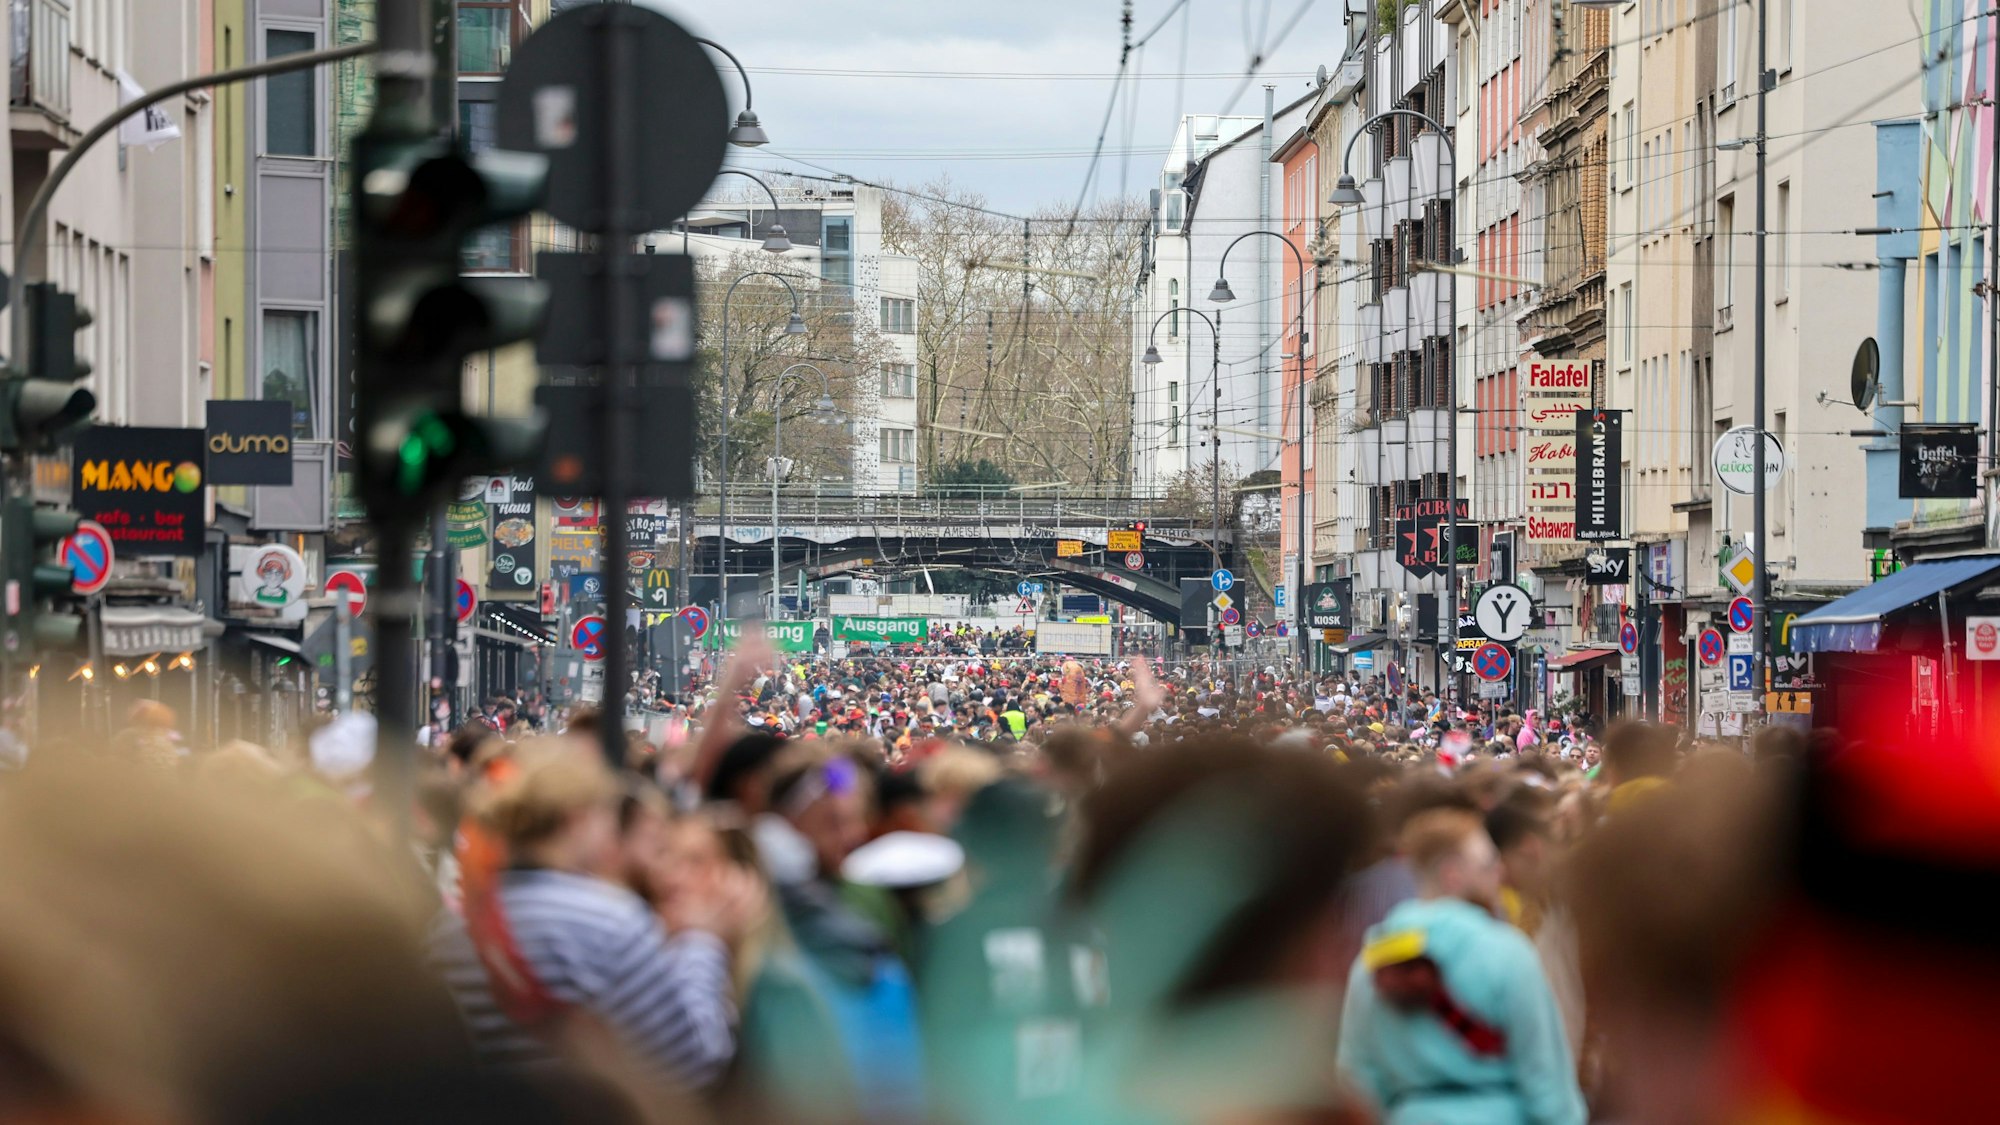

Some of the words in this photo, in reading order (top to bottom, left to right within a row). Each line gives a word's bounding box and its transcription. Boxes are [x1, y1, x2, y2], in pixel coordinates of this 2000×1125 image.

[1530, 364, 1588, 388] Falafel
[209, 431, 289, 453] duma
[1529, 442, 1576, 463] Habi
[82, 459, 201, 493] MANGO
[1720, 460, 1779, 475] GLÜCKSHN
[155, 509, 185, 526] bar
[630, 533, 650, 541] PITA
[1591, 559, 1625, 577] sky
[842, 617, 919, 635] Ausgang
[1314, 615, 1341, 625] KIOSK
[1732, 658, 1747, 687] P
